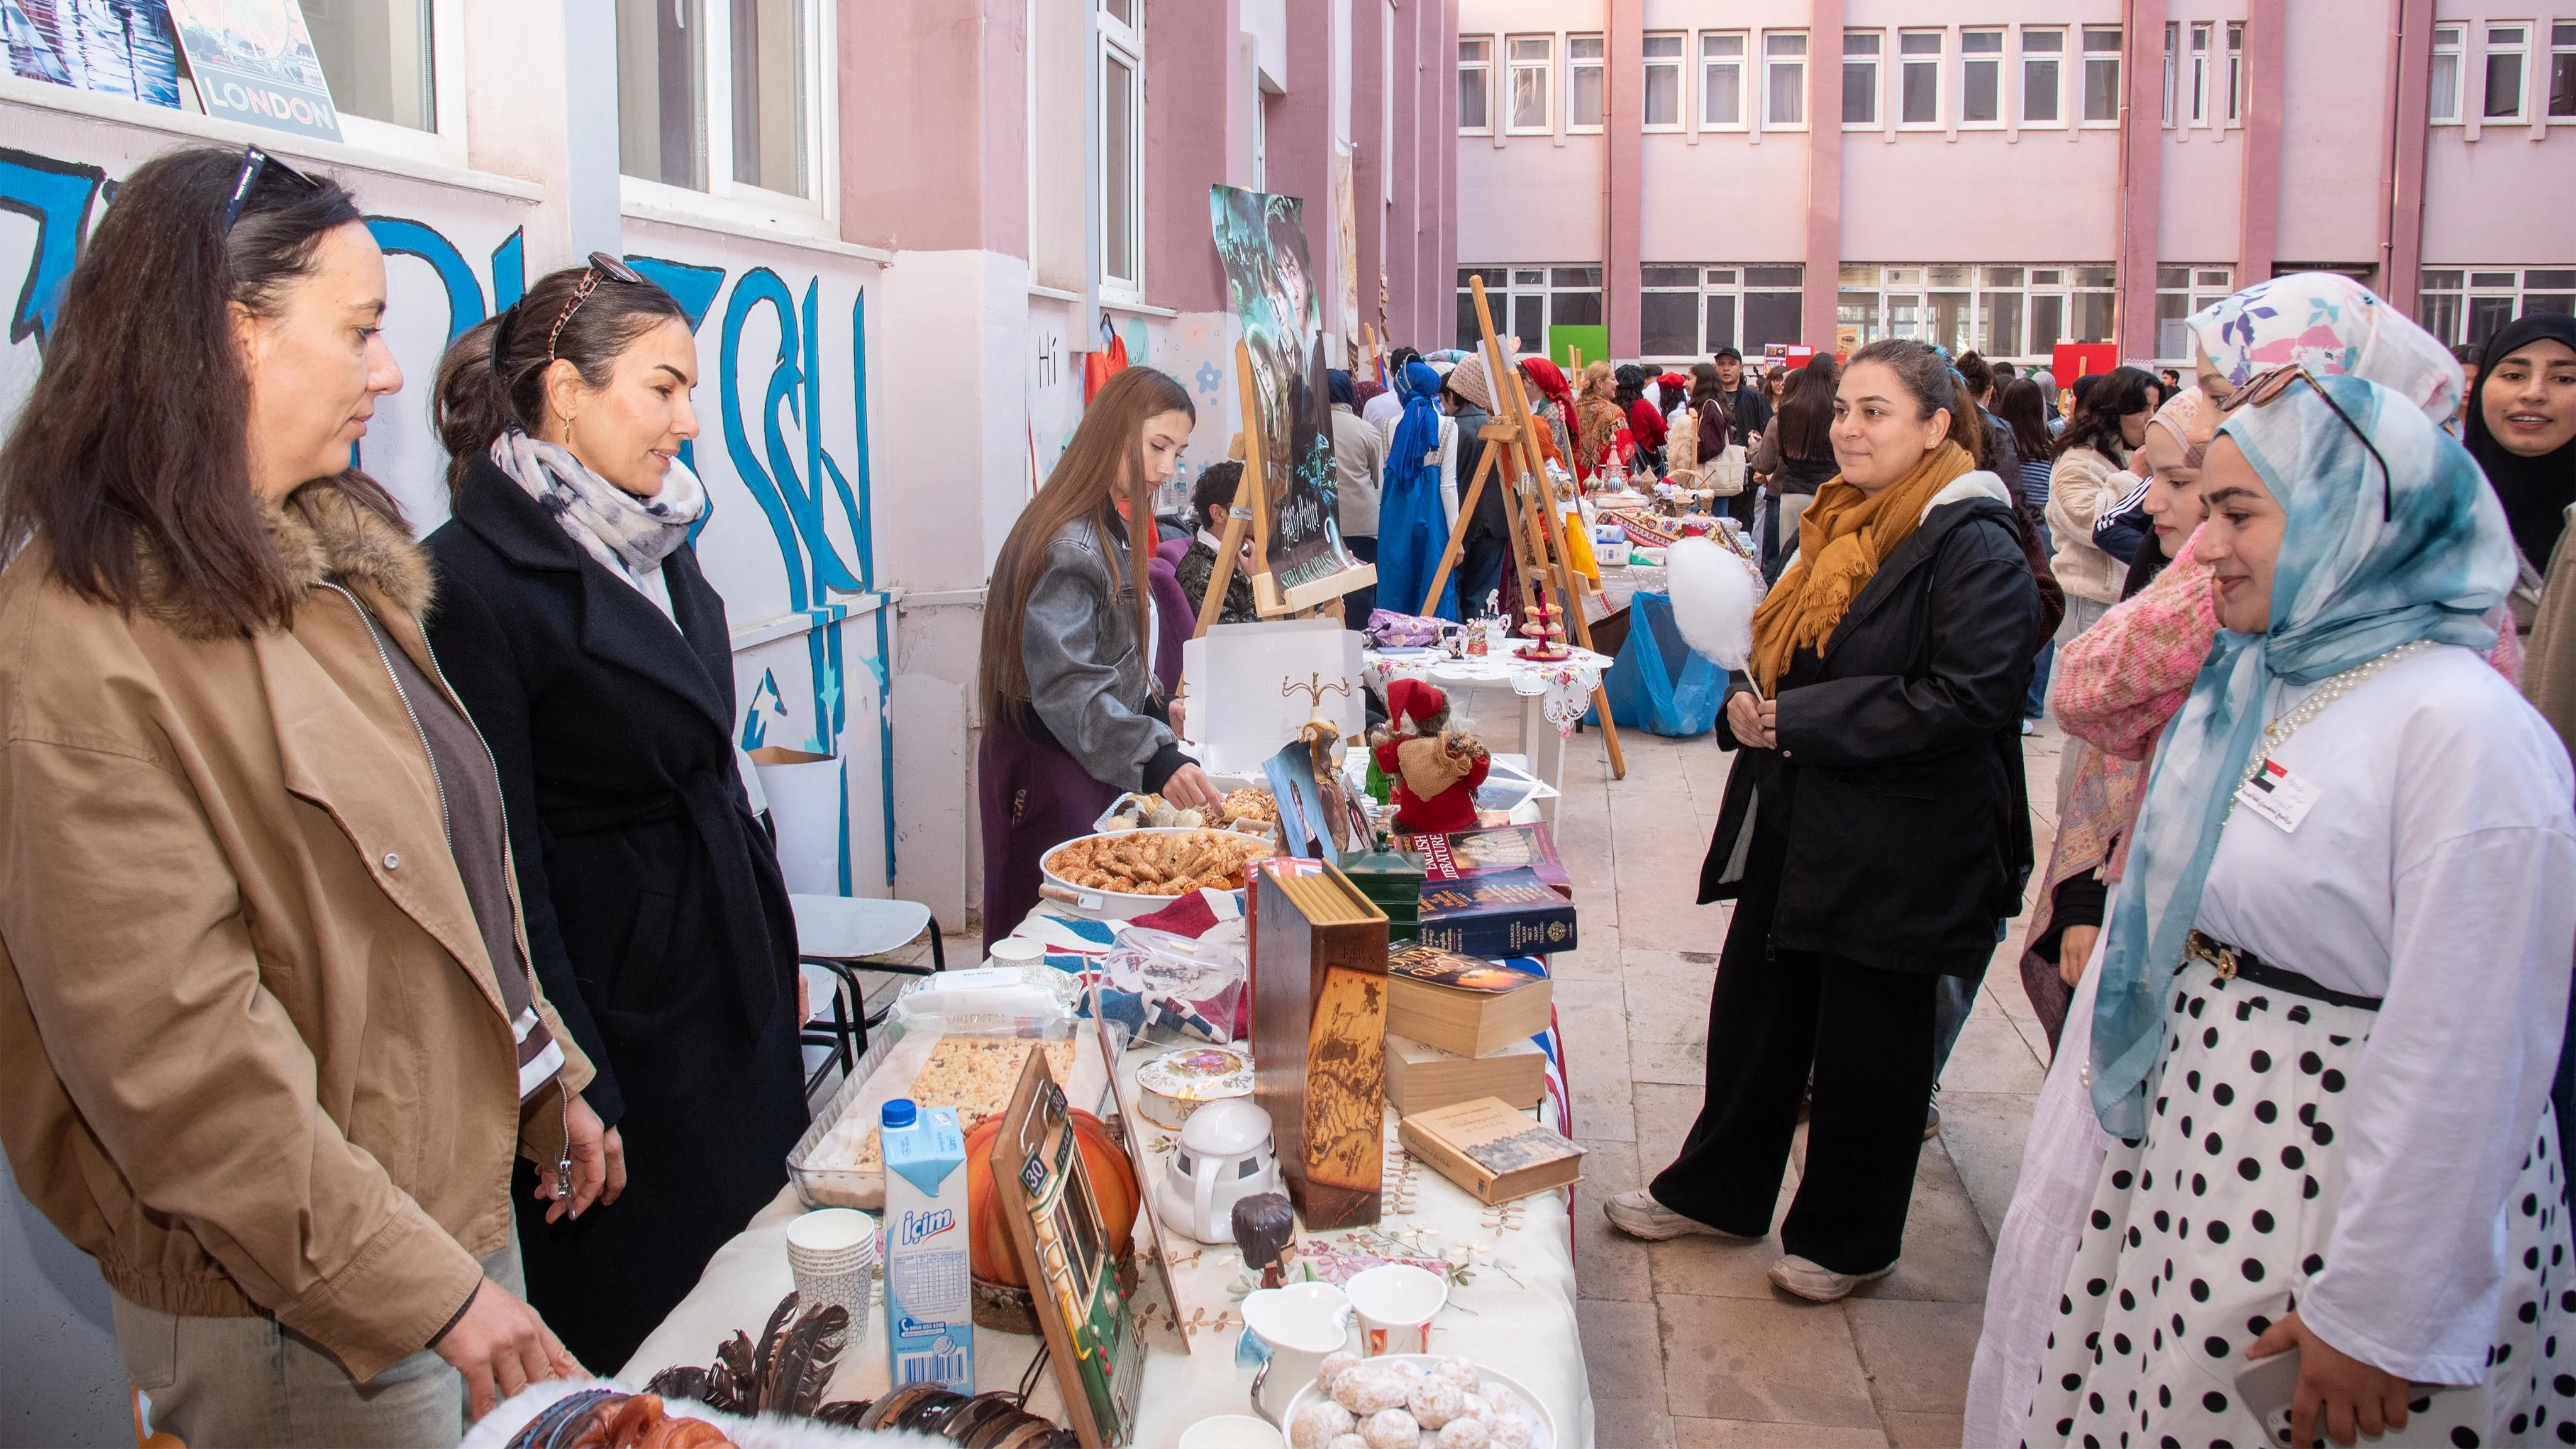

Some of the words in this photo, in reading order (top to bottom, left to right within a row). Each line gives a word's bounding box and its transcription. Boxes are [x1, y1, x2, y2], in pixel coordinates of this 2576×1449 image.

[204, 77, 335, 130] LONDON
[1297, 494, 1320, 543] Potter
[1414, 835, 1438, 870] ENGLISH
[1430, 833, 1459, 879] ITERATURE
[1349, 955, 1375, 964] RINGS
[1411, 955, 1477, 977] LORD
[1052, 1089, 1065, 1111] 30
[1057, 1128, 1073, 1168] TRAM
[1026, 1159, 1044, 1189] 30
